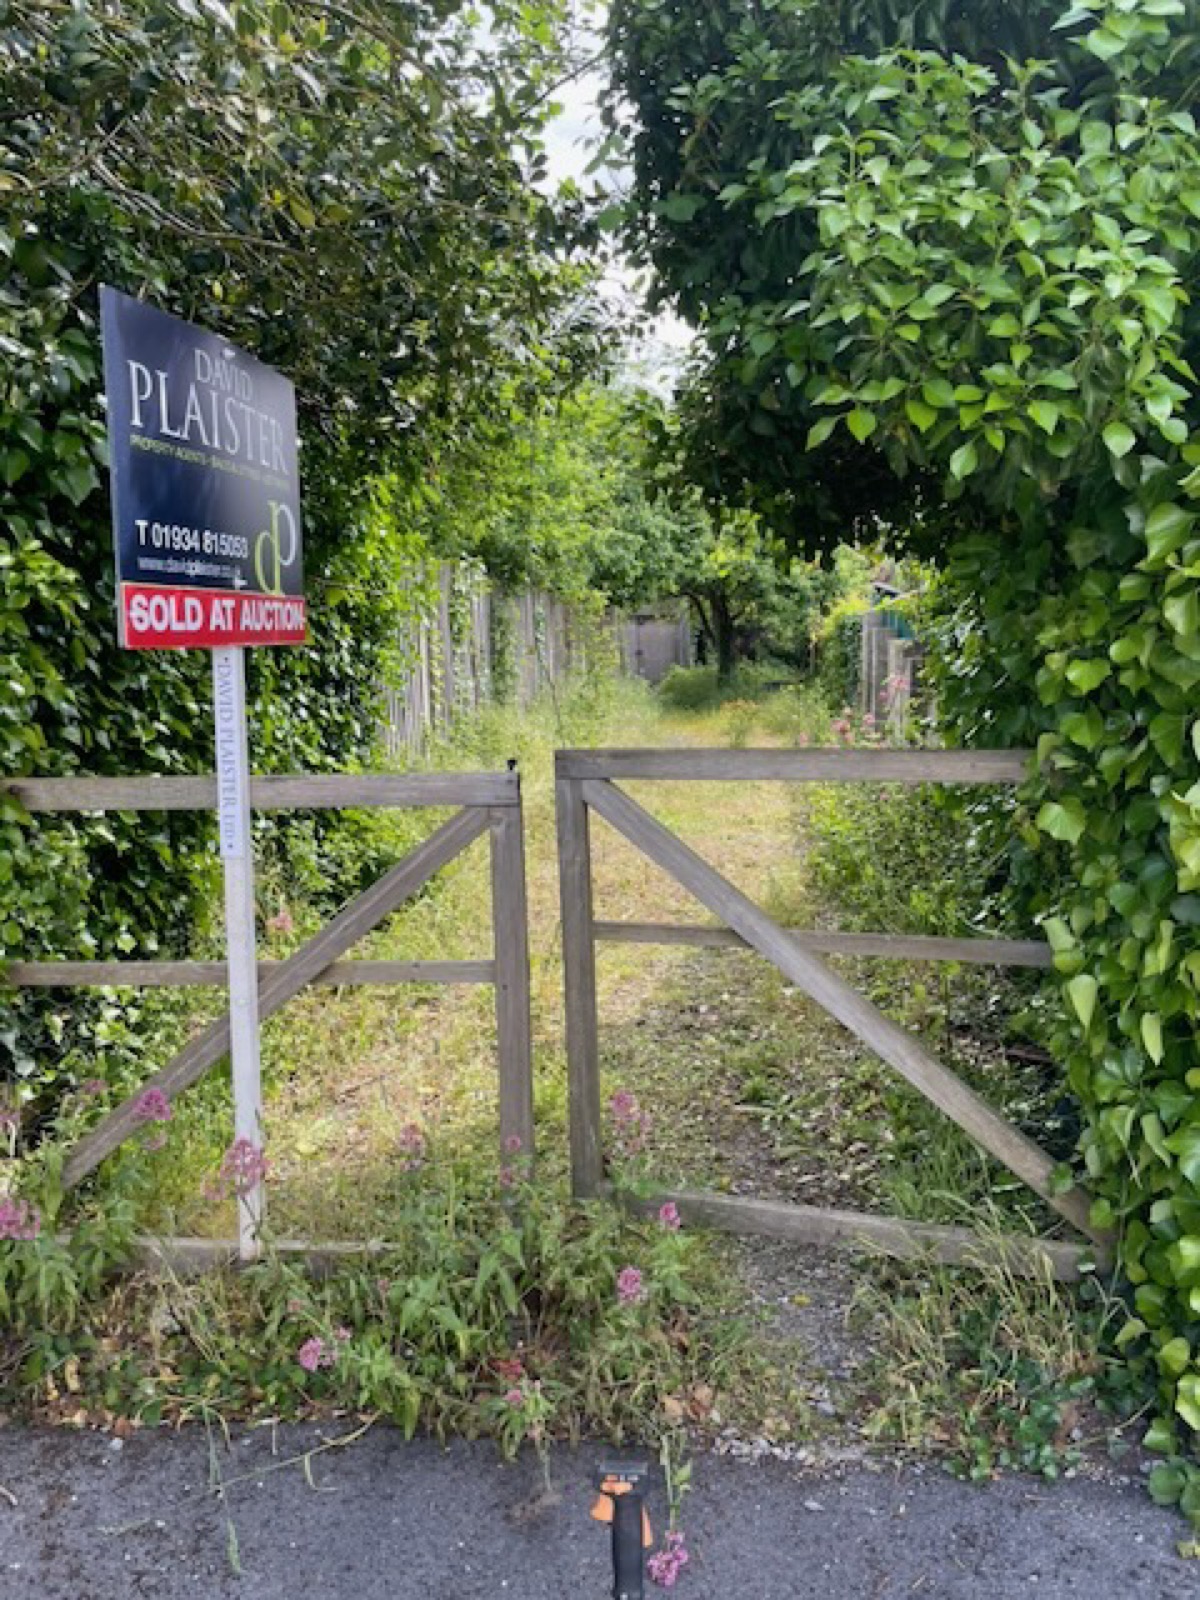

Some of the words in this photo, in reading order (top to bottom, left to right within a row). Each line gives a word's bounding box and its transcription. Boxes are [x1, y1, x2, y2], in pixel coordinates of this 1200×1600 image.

[195, 349, 253, 401] DAVID
[127, 360, 287, 475] PLAISTER
[134, 519, 149, 546] T
[151, 523, 200, 553] 01934
[129, 594, 204, 632] SOLD
[209, 598, 236, 631] AT
[239, 600, 304, 631] AUCTION
[217, 664, 233, 723] DAVID
[220, 730, 236, 808] PLAISTER
